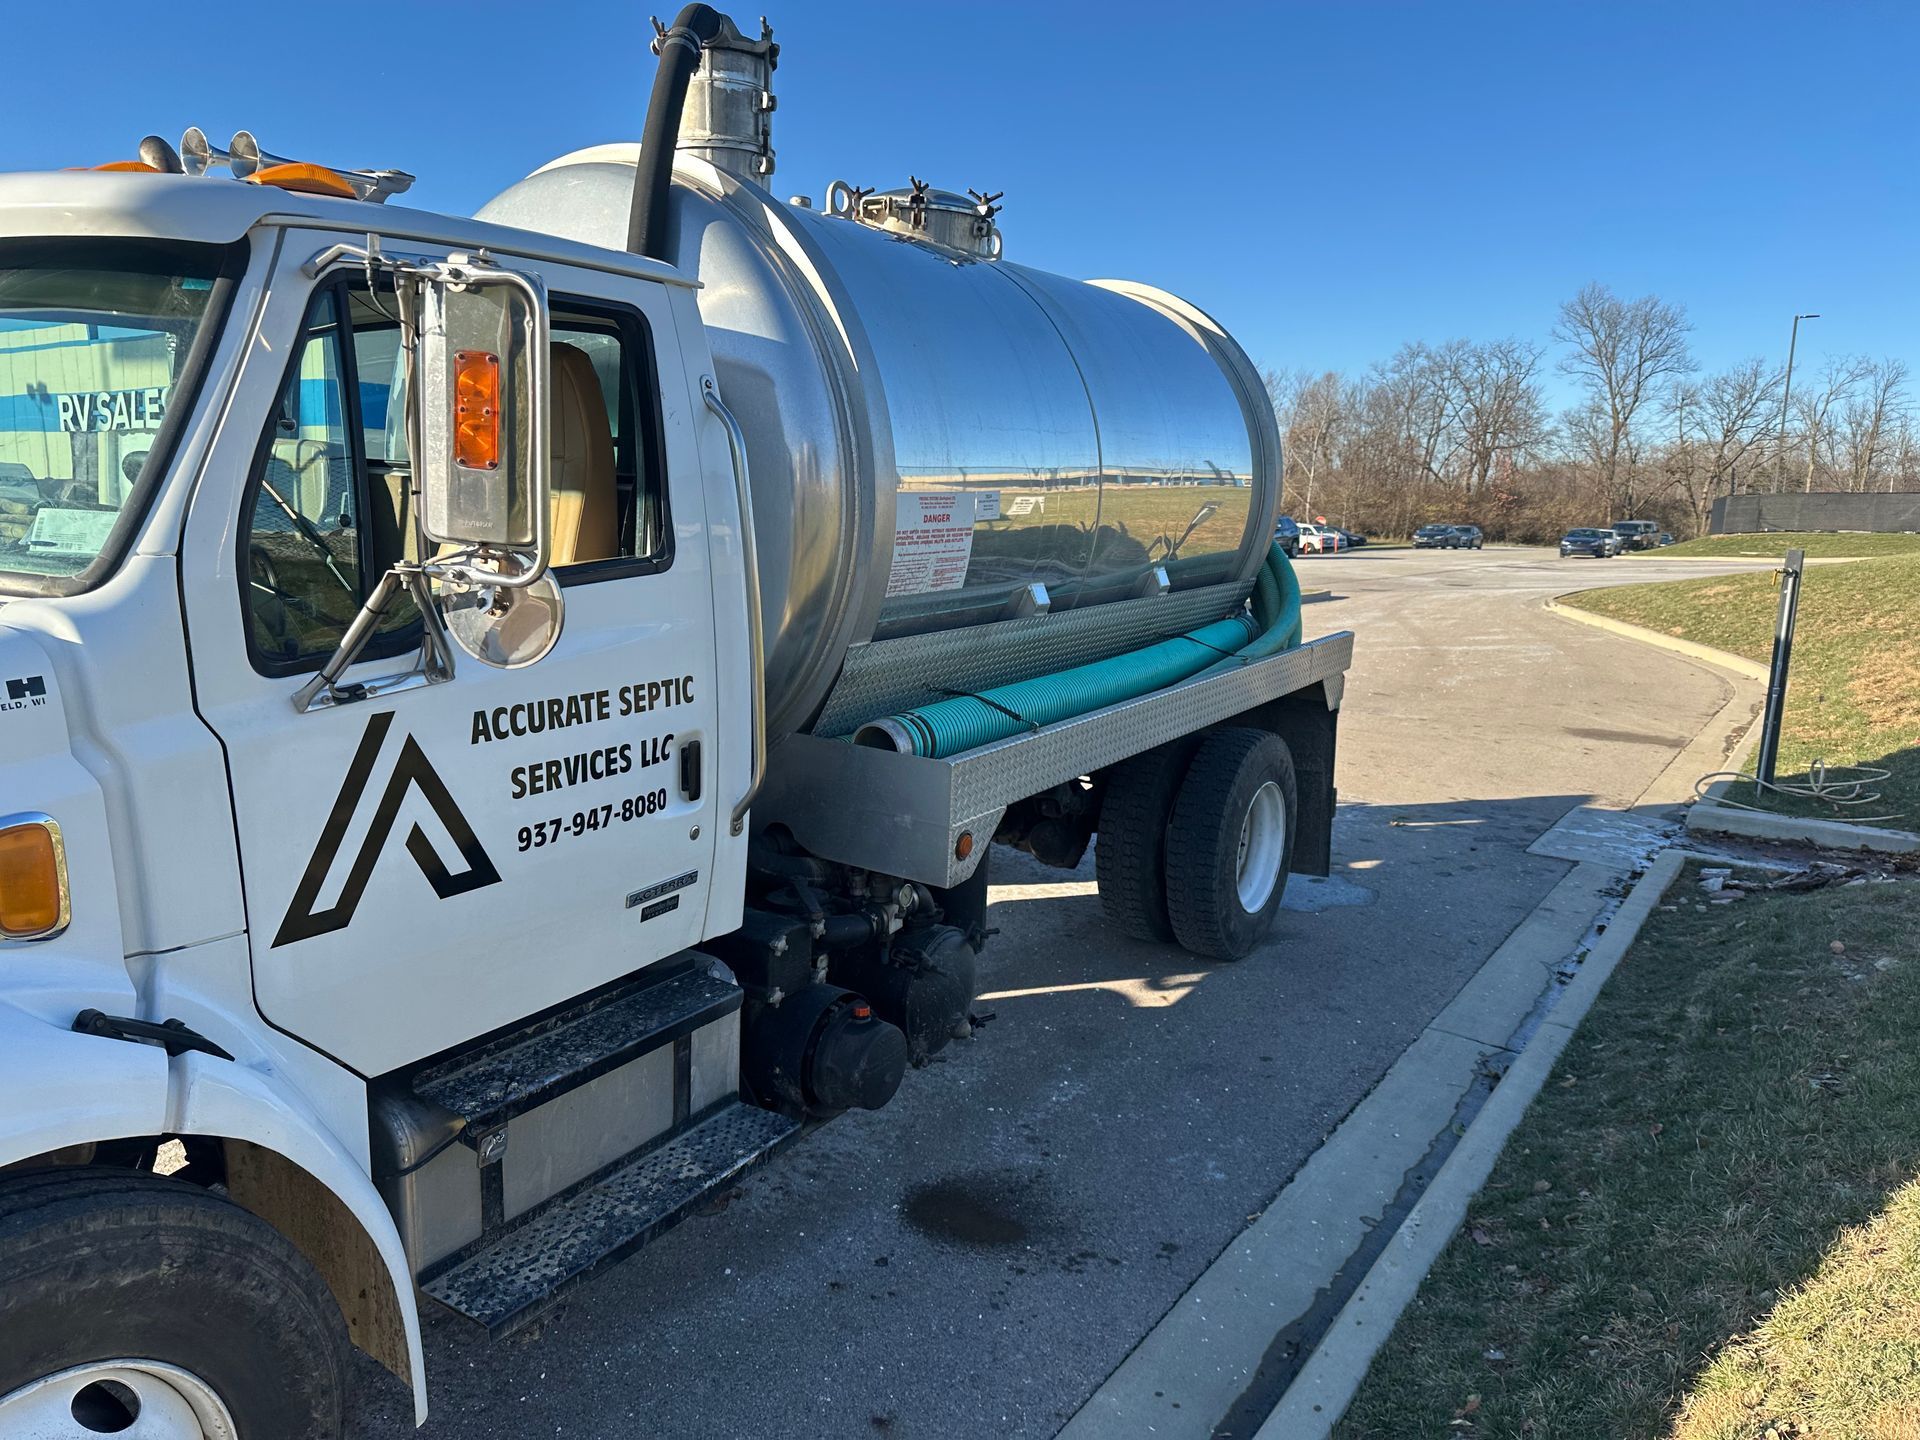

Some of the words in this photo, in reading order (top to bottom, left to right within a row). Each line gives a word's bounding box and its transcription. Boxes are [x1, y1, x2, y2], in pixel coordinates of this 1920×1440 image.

[57, 394, 90, 432] RV
[923, 513, 951, 523] DANGER
[31, 697, 46, 706] WI
[471, 689, 610, 745] ACCURATE
[618, 675, 695, 716] SEPTIC
[511, 743, 632, 799] SERVICES
[640, 733, 675, 768] LLC
[517, 788, 667, 852] 937-947-8080
[632, 873, 698, 904] ACTERRA
